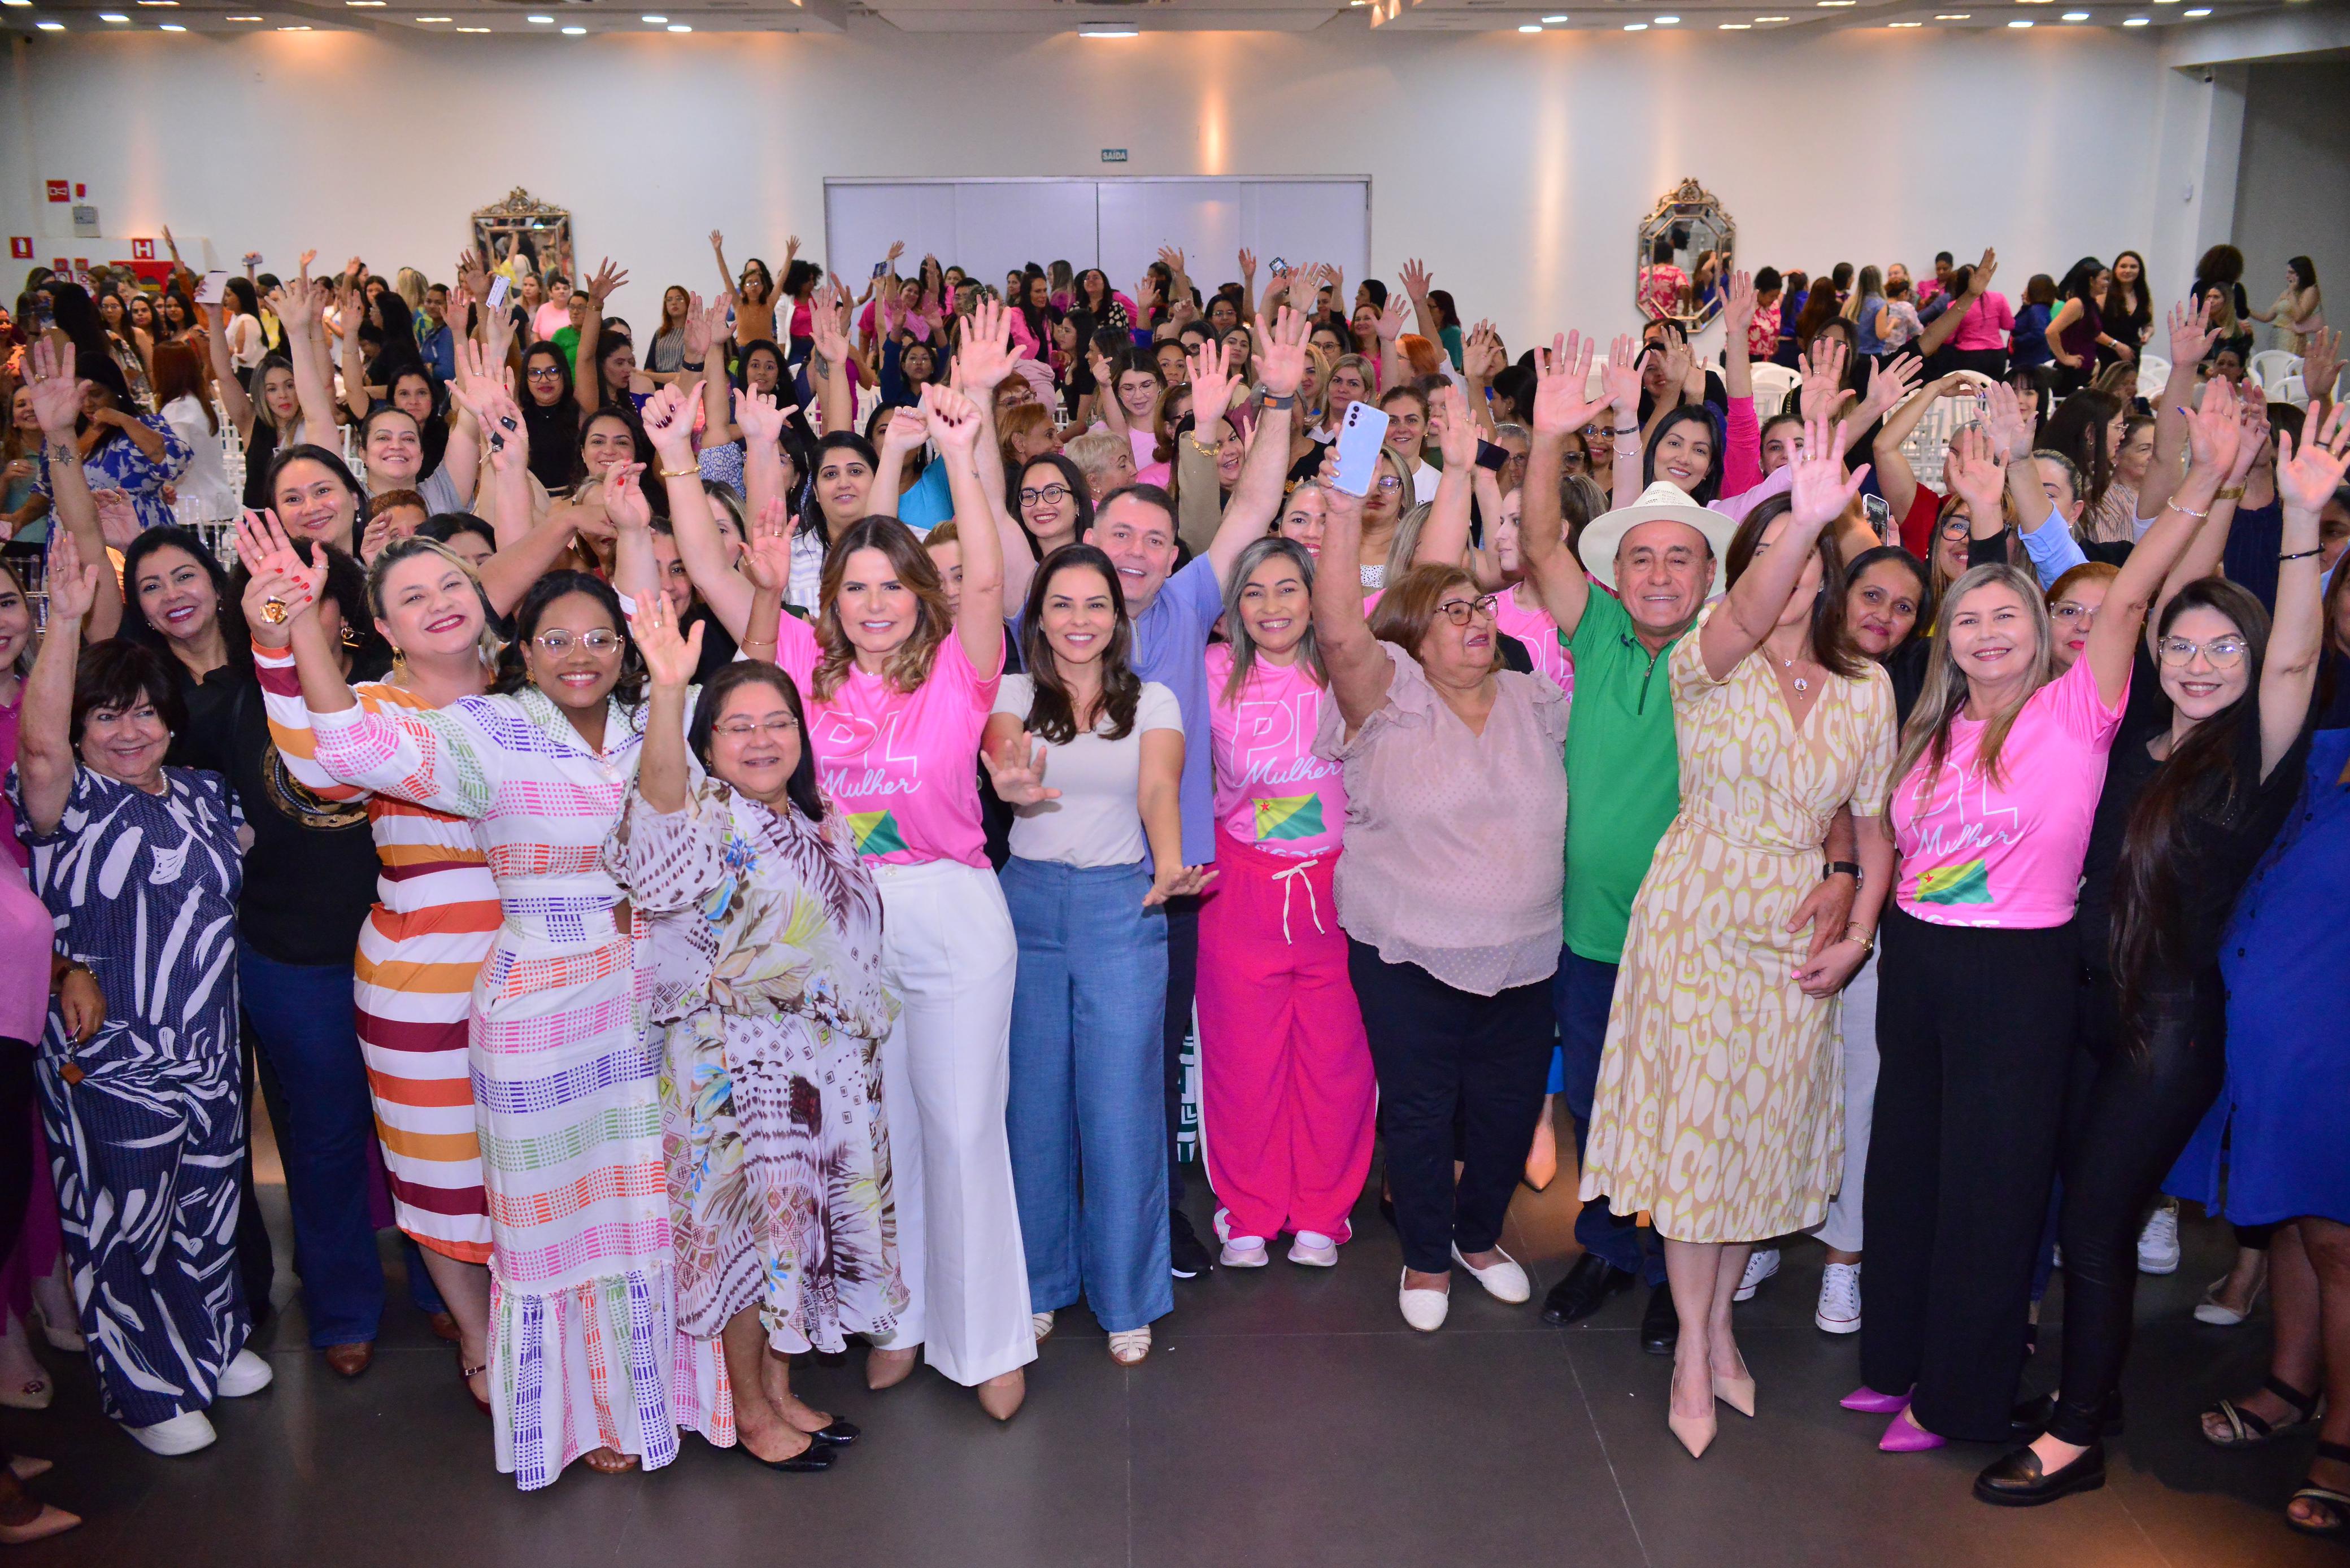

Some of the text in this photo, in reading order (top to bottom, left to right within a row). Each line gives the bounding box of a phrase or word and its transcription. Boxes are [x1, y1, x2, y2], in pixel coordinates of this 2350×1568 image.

[135, 241, 152, 257] H
[809, 710, 917, 777] PL
[822, 767, 922, 798] Mulher
[1233, 756, 1343, 789] Mulher
[1893, 759, 2018, 840] PL
[1902, 822, 2024, 860] Mulher
